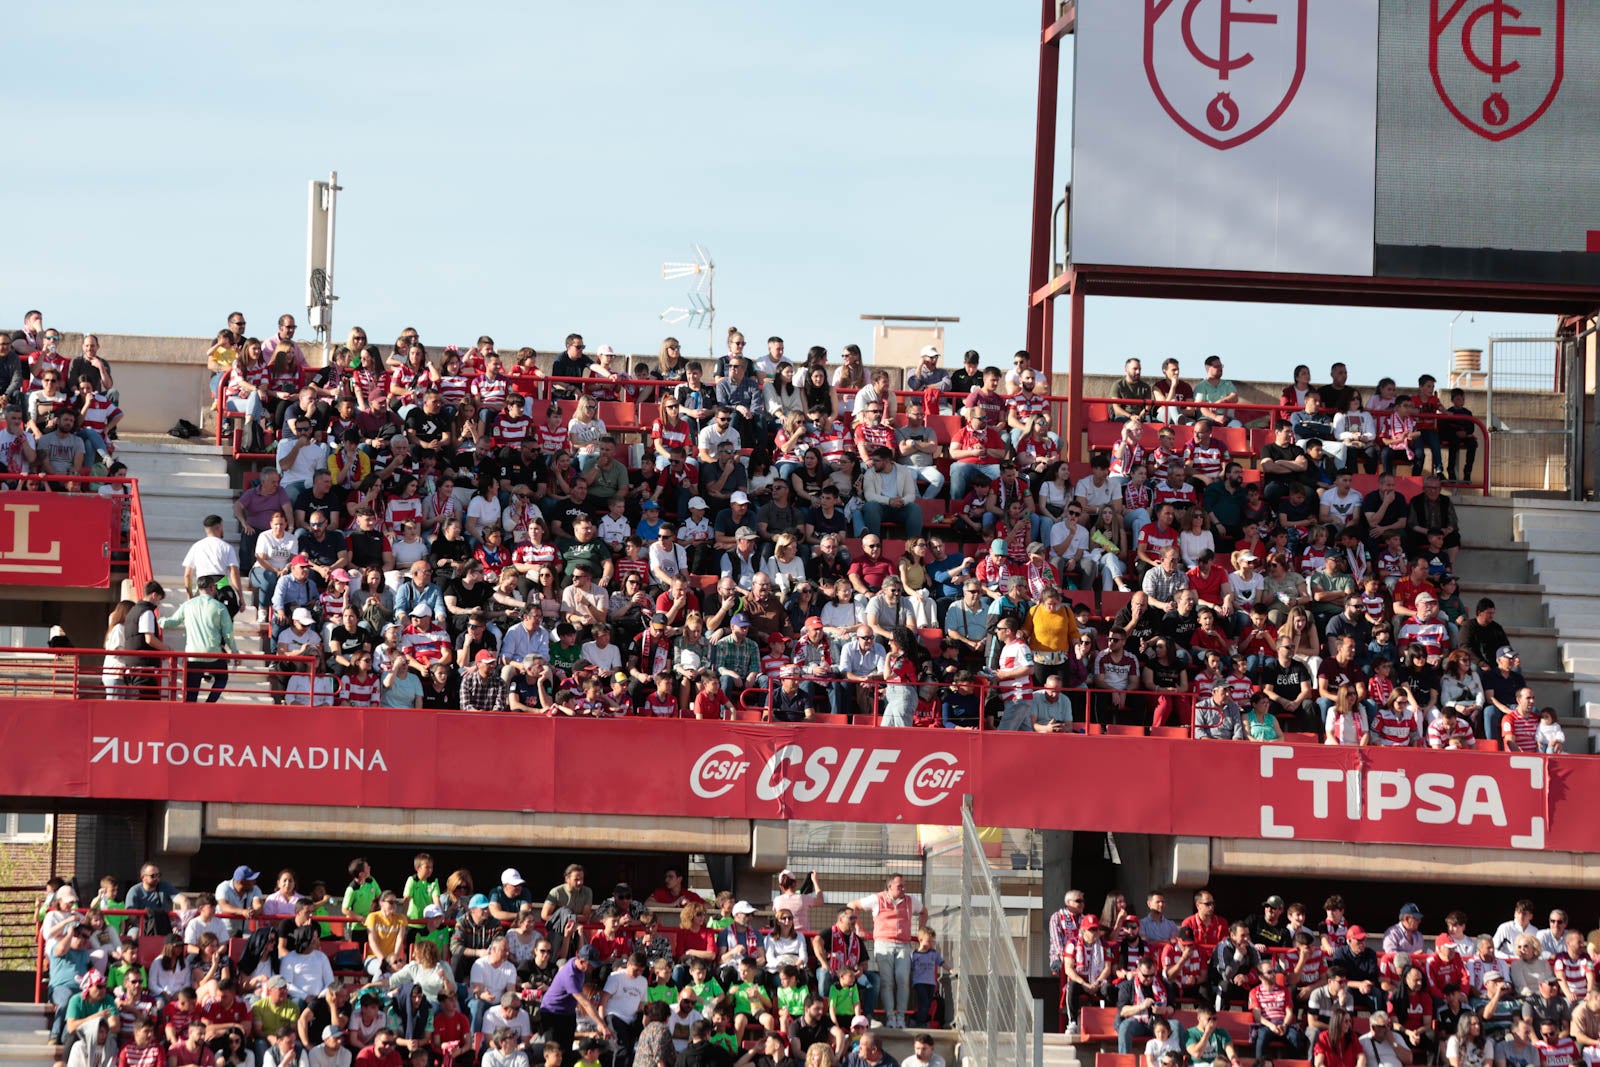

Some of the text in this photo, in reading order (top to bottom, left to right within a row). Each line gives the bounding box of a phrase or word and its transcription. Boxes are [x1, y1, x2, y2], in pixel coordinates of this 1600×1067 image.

[89, 736, 388, 772] AUTOGRANADINA
[702, 759, 751, 781] CSIF
[755, 743, 902, 805] CSIF
[915, 767, 965, 789] CSIF
[1296, 767, 1508, 827] TIPSA
